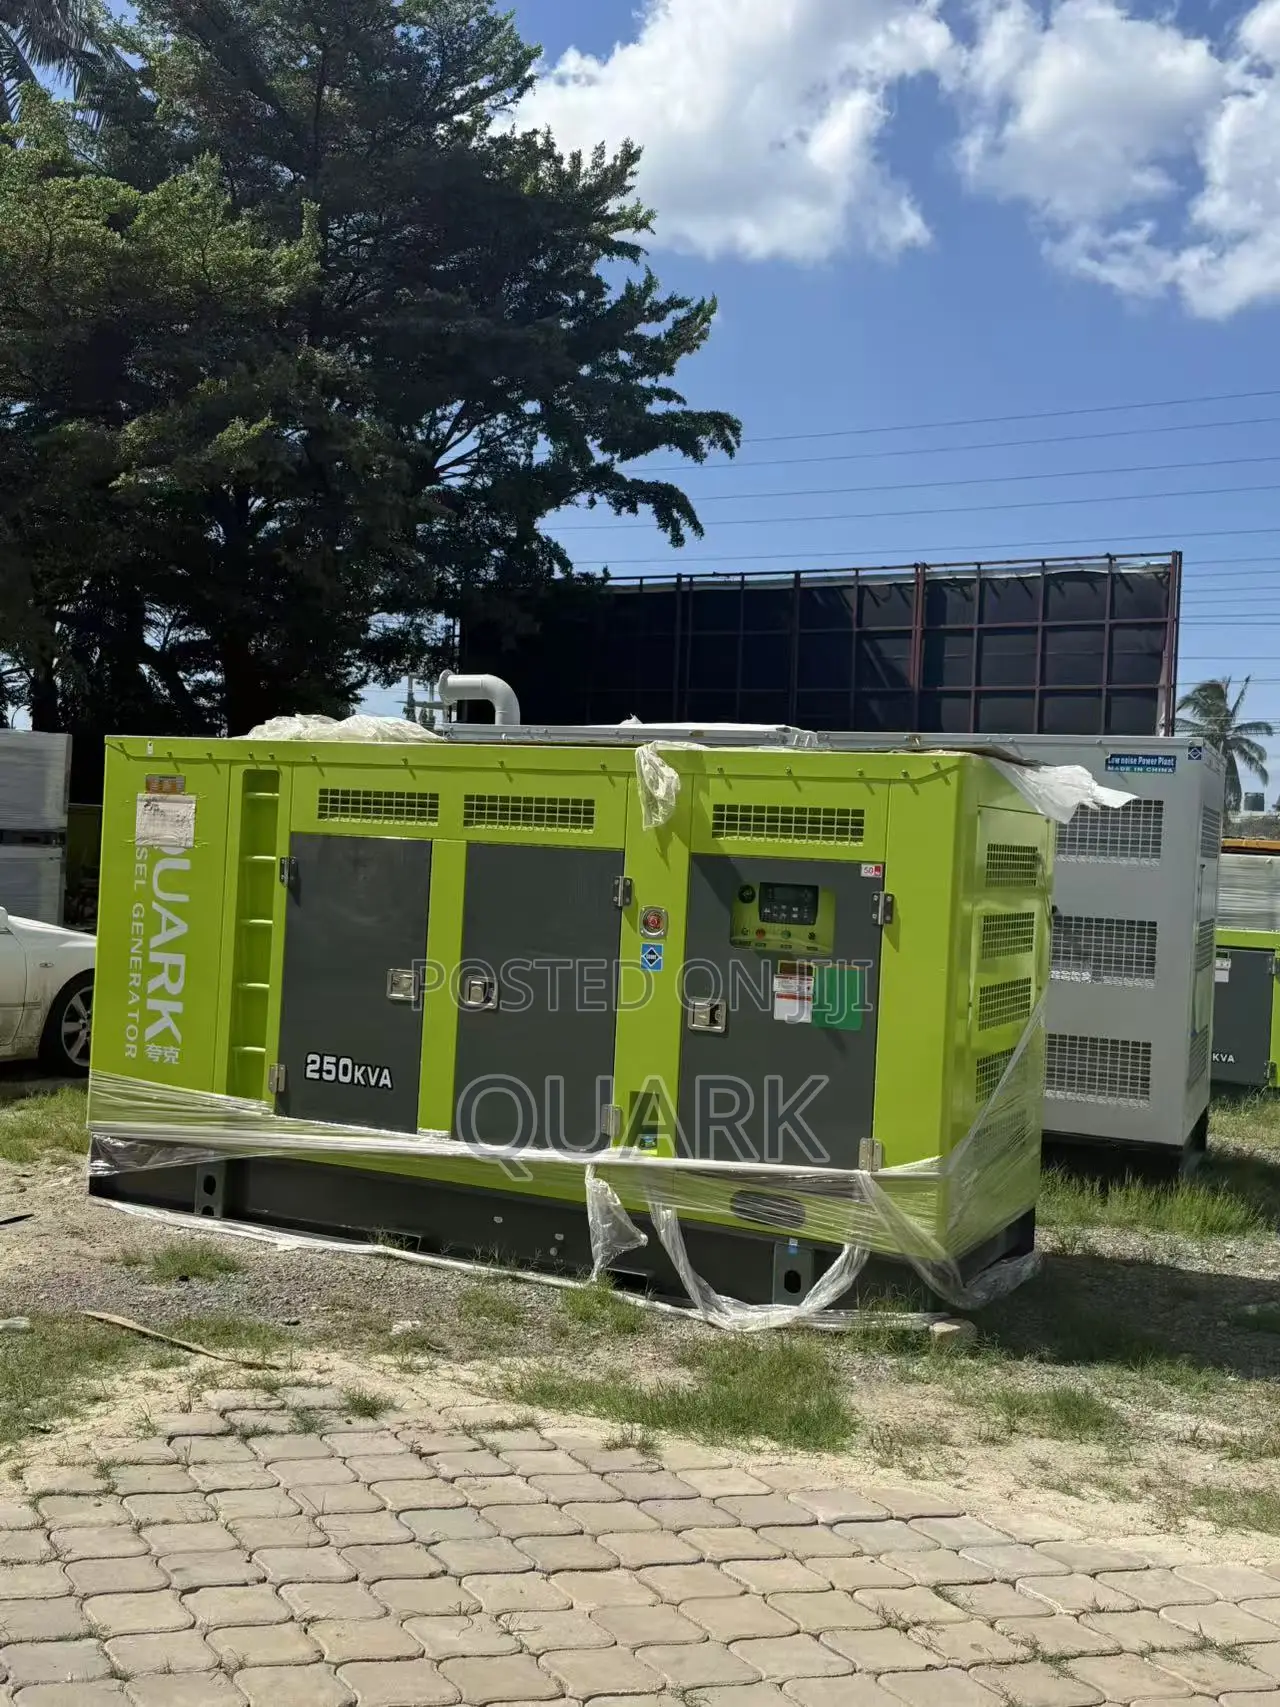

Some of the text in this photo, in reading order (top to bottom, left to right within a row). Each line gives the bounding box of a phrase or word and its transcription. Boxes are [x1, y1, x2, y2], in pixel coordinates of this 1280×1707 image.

[1138, 756, 1157, 766] Power
[1158, 757, 1174, 766] Plant
[124, 846, 148, 1058] SEL GENERATOR
[144, 847, 191, 1044] UARK
[305, 1053, 392, 1088] 250KVA
